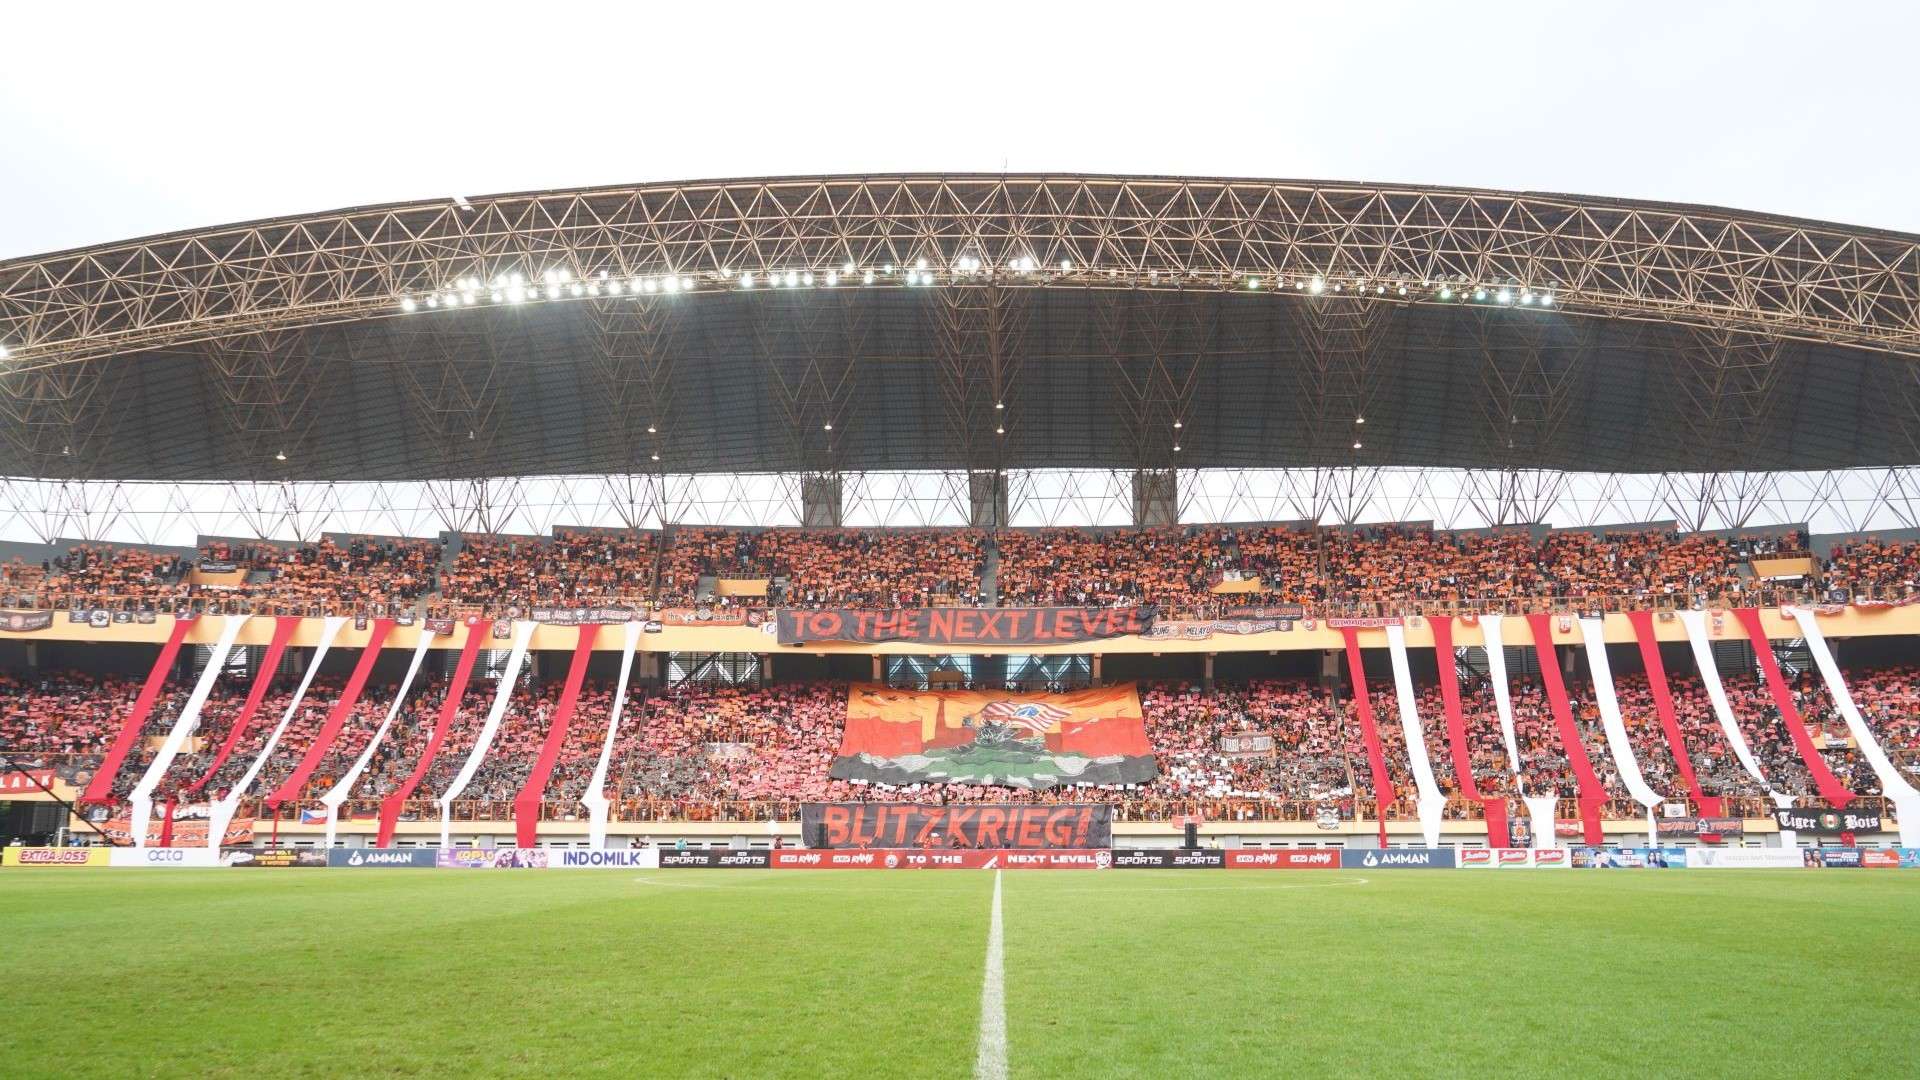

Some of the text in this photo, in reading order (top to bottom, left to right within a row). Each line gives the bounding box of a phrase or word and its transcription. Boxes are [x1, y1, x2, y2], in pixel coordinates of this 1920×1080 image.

[790, 608, 1143, 642] TO THE NEXT LEVEL
[823, 804, 1093, 848] BLITZKRIEG!
[1779, 812, 1879, 829] Tiger Bois
[20, 849, 88, 862] EXTRA JOSS
[148, 849, 183, 861] octa
[365, 853, 412, 864] AMMAN
[563, 851, 640, 866] INDOMILK
[662, 856, 709, 865] SPORTS
[719, 856, 766, 865] SPORTS
[907, 855, 962, 864] TO THE
[1007, 855, 1096, 864] NEXT LEVEL
[1115, 855, 1163, 865] SPORTS
[1173, 855, 1220, 865] SPORTS
[1381, 853, 1429, 864] AMMAN
